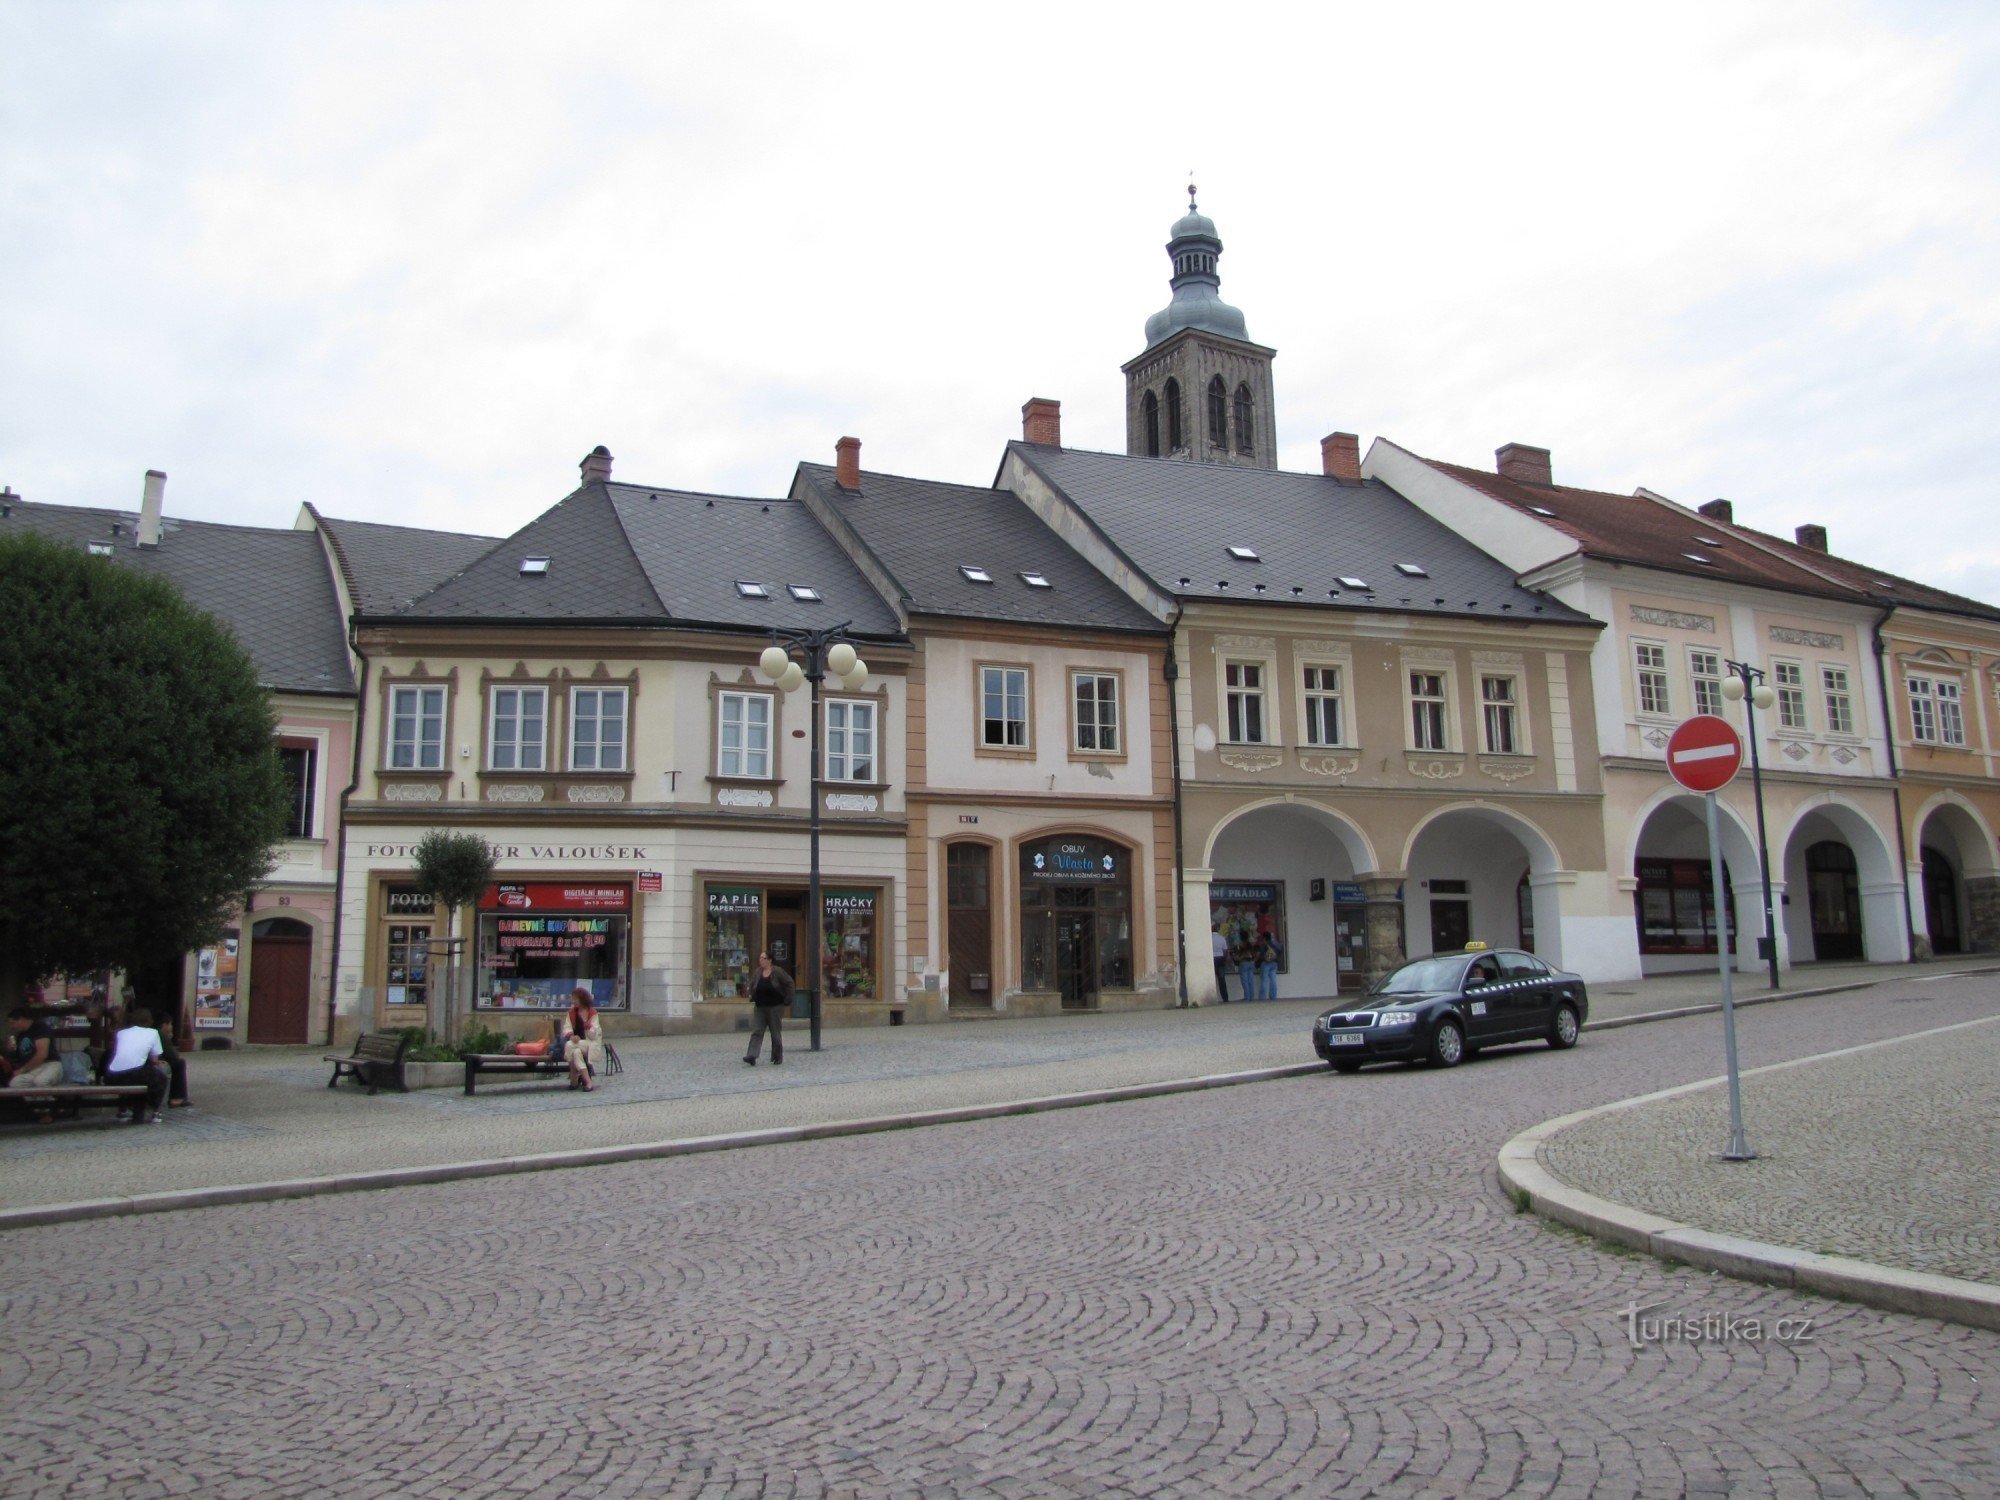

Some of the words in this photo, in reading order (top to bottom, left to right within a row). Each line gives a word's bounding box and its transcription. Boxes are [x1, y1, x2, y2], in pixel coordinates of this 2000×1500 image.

[531, 844, 647, 859] VALOUŠEK
[1061, 844, 1086, 853] OBUV
[1052, 854, 1094, 869] Vlasta
[597, 889, 624, 897] MINILAB
[390, 893, 433, 905] FOTO
[710, 894, 759, 905] PAPÍR
[826, 896, 873, 908] HRAČKY
[709, 904, 734, 912] PAPER
[826, 907, 849, 915] TOYS
[498, 918, 545, 932] BAREVNÉ
[547, 918, 609, 932] KOPÍROVÁNÍ
